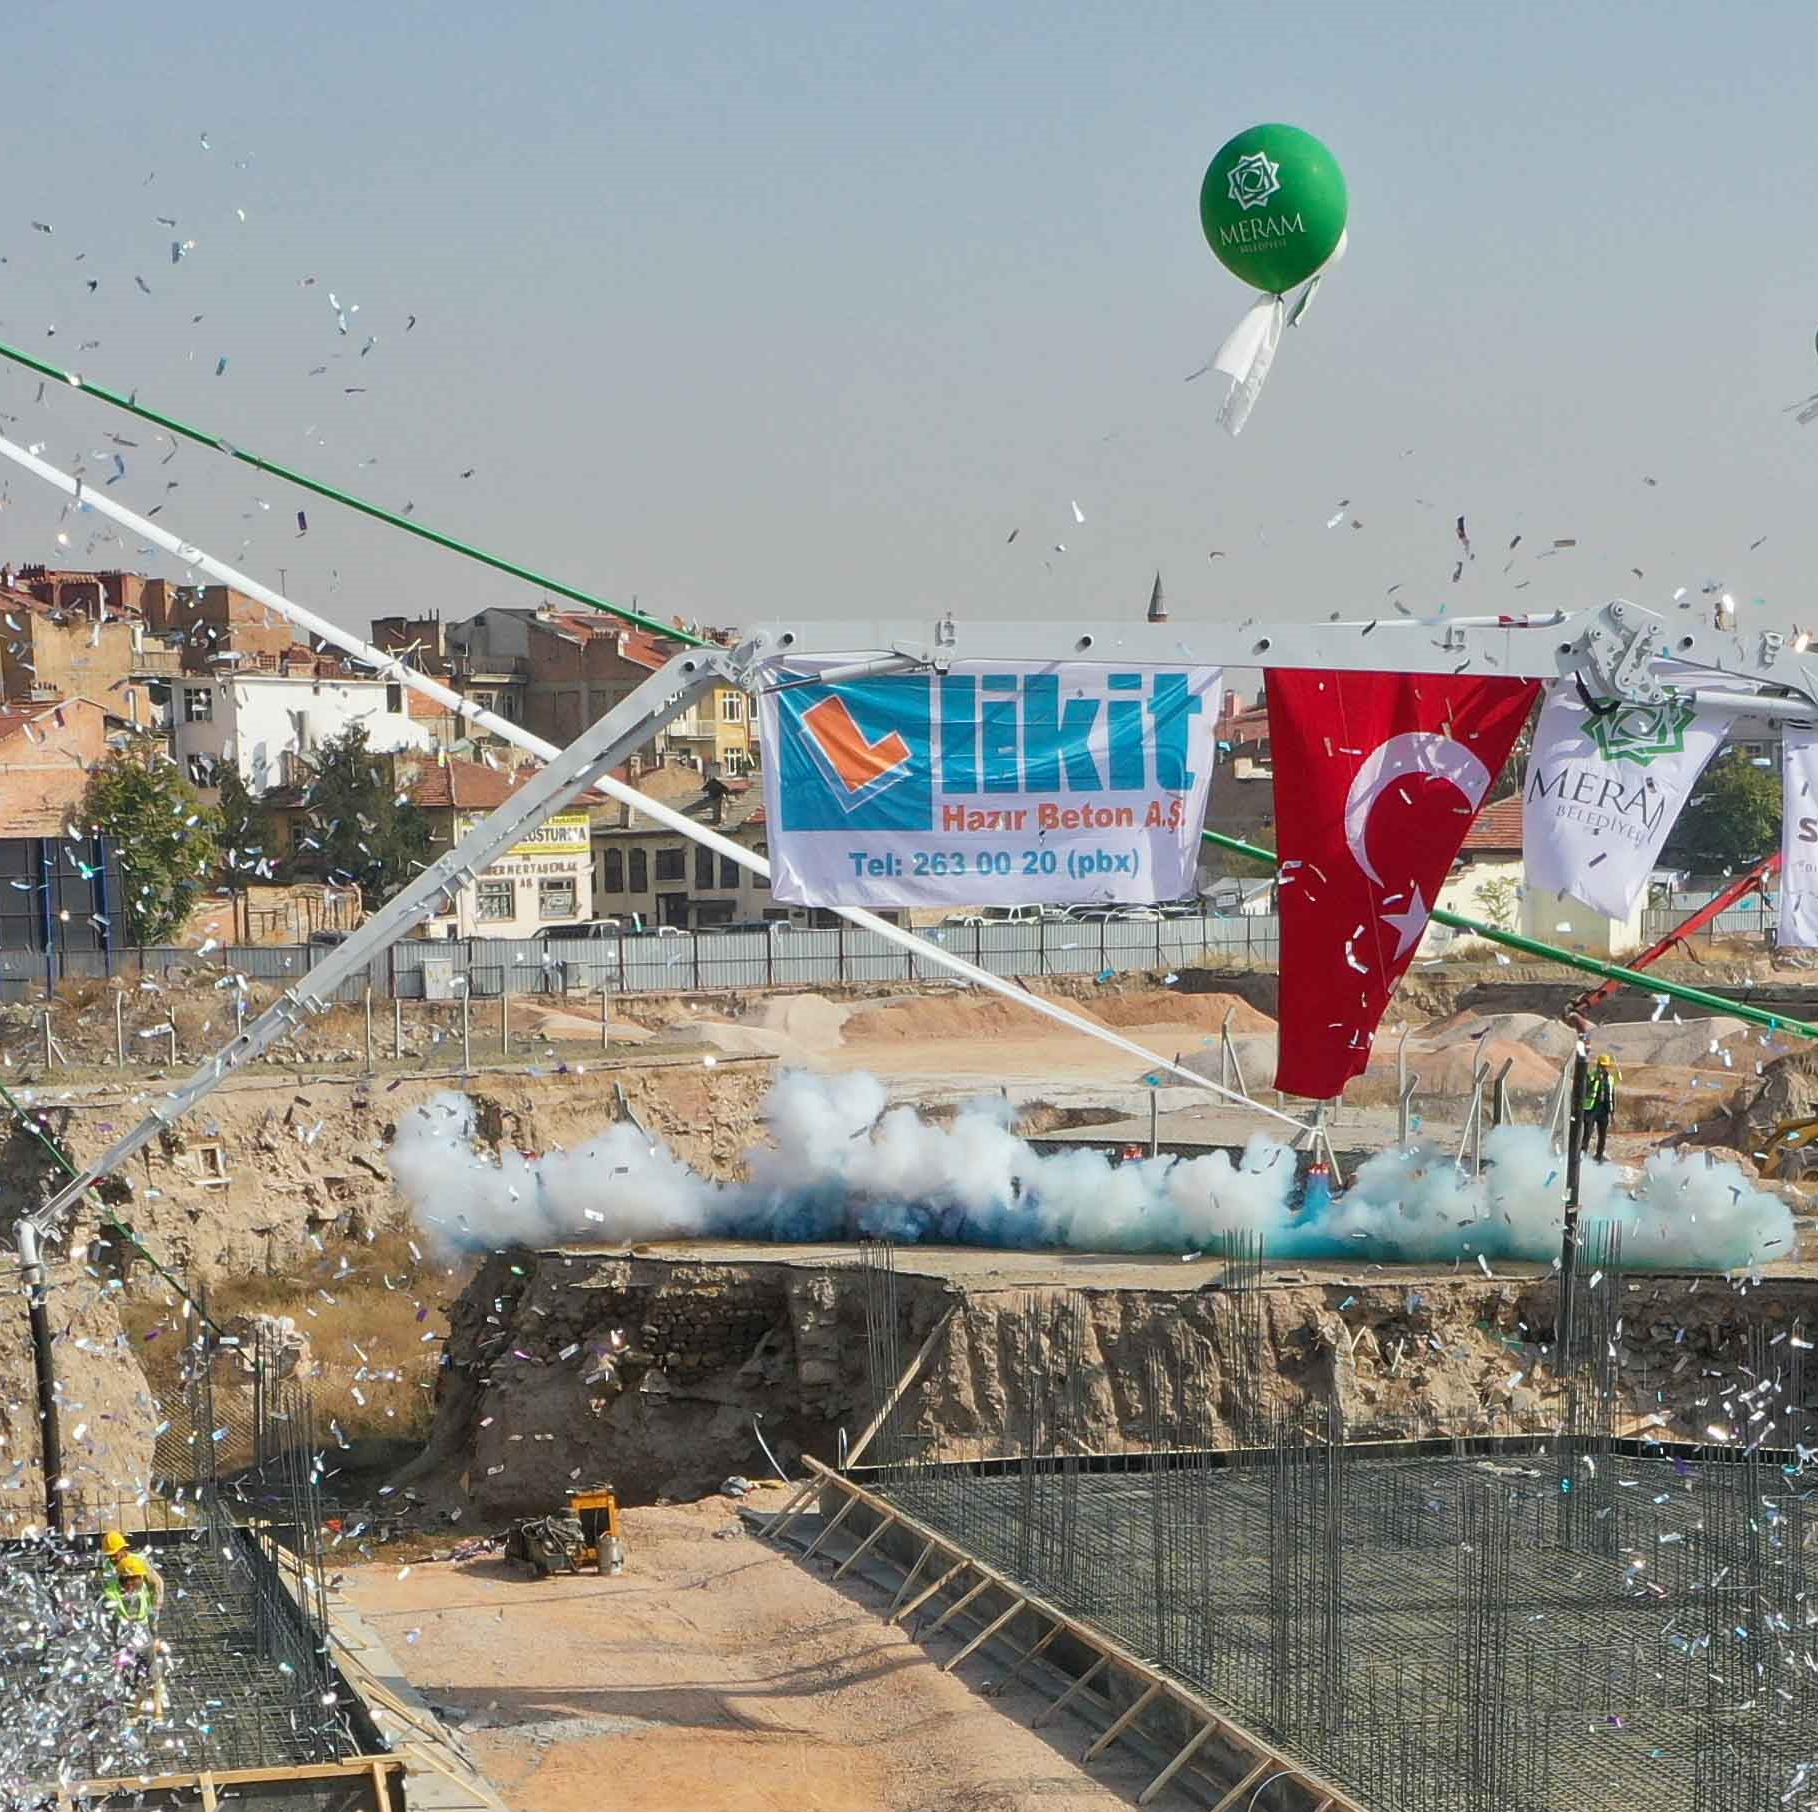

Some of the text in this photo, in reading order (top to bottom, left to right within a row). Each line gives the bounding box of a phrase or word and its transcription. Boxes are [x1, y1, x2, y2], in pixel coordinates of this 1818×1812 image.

[1220, 212, 1308, 246] MERAM
[941, 673, 1202, 794] likit
[942, 803, 1028, 832] Hazır
[1038, 801, 1133, 831] Beton
[848, 847, 1140, 879] Tel: 263 00 20 (pbx)
